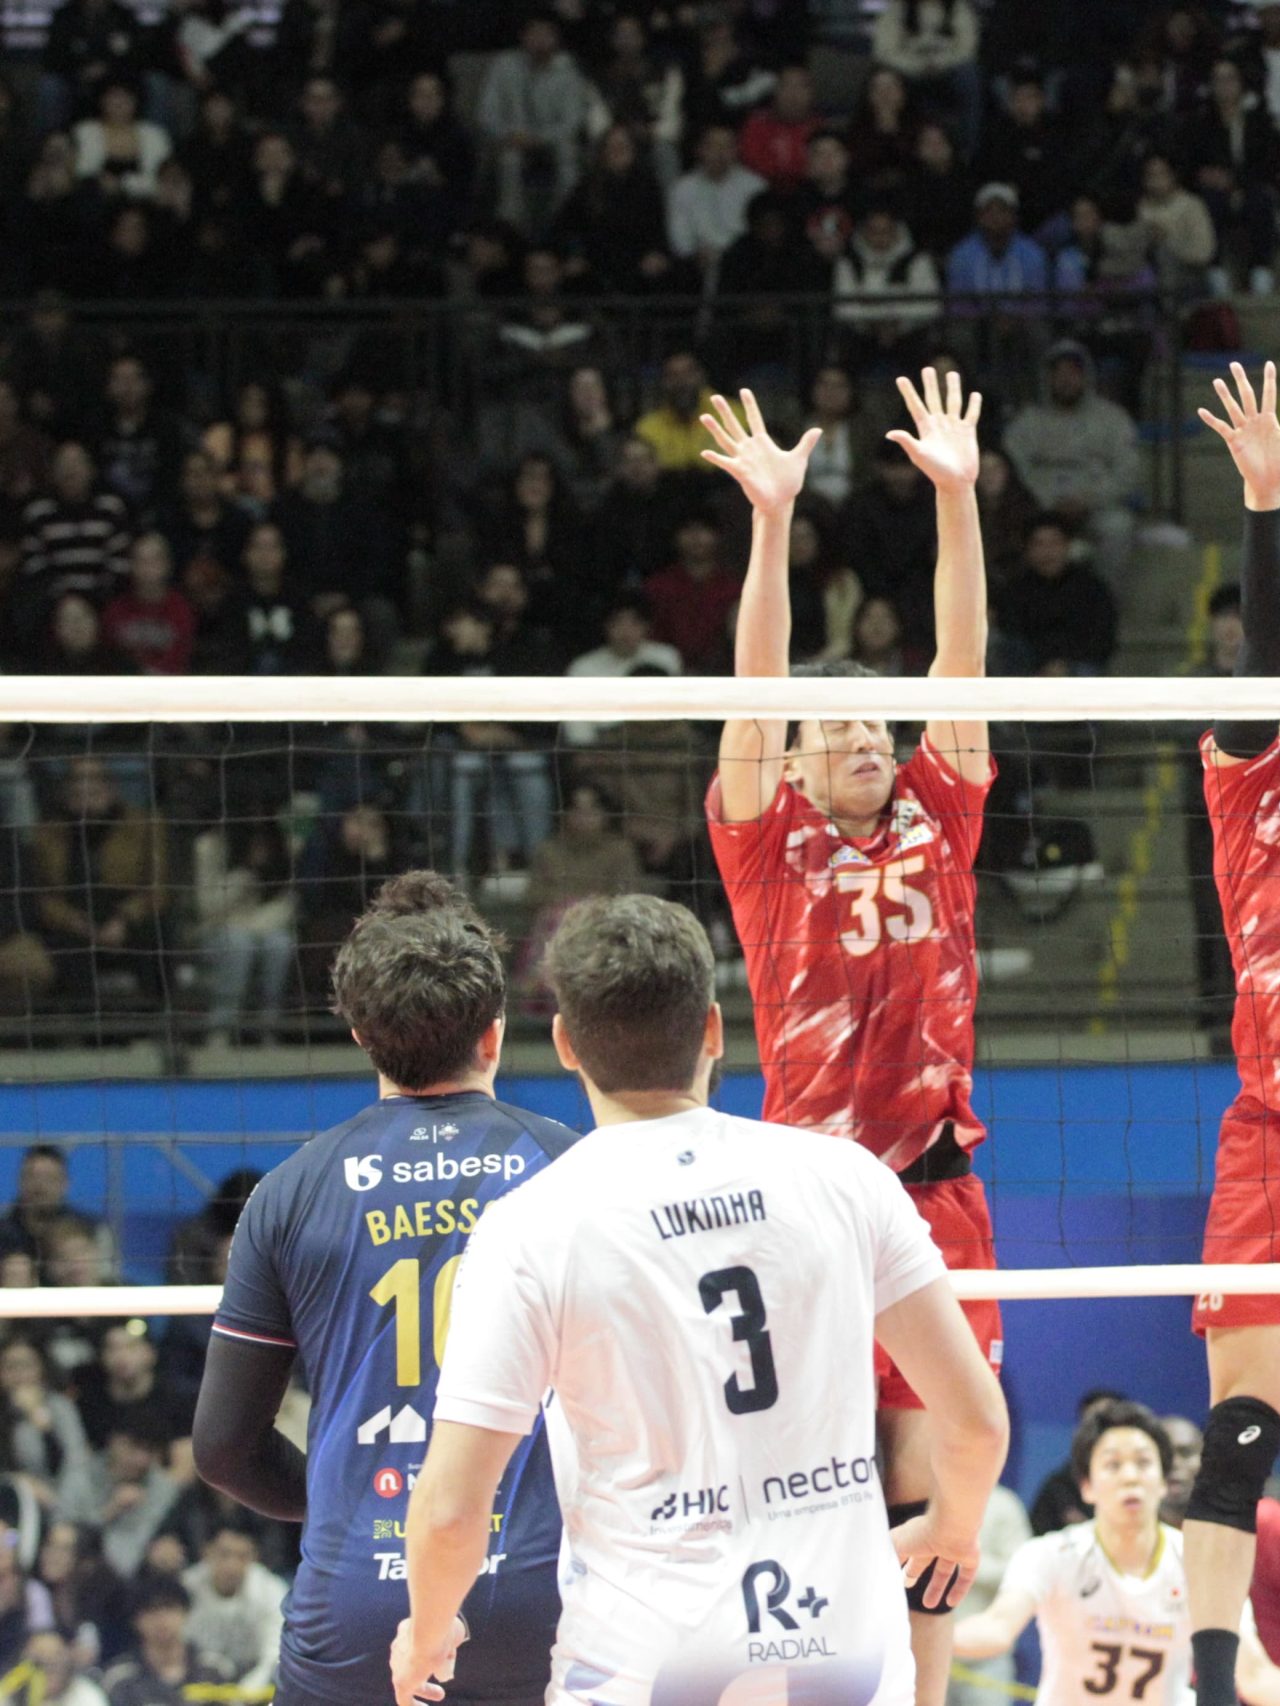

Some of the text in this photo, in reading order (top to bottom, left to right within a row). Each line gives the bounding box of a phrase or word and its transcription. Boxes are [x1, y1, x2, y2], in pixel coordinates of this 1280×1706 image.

[836, 854, 933, 957] 35
[393, 1151, 526, 1184] sabesp
[365, 1198, 495, 1247] BAESS
[650, 1189, 766, 1240] LUKINHA
[698, 1266, 779, 1415] 3
[682, 1485, 729, 1517] HIC
[748, 1637, 838, 1663] RADIAL
[1083, 1641, 1164, 1700] 37
